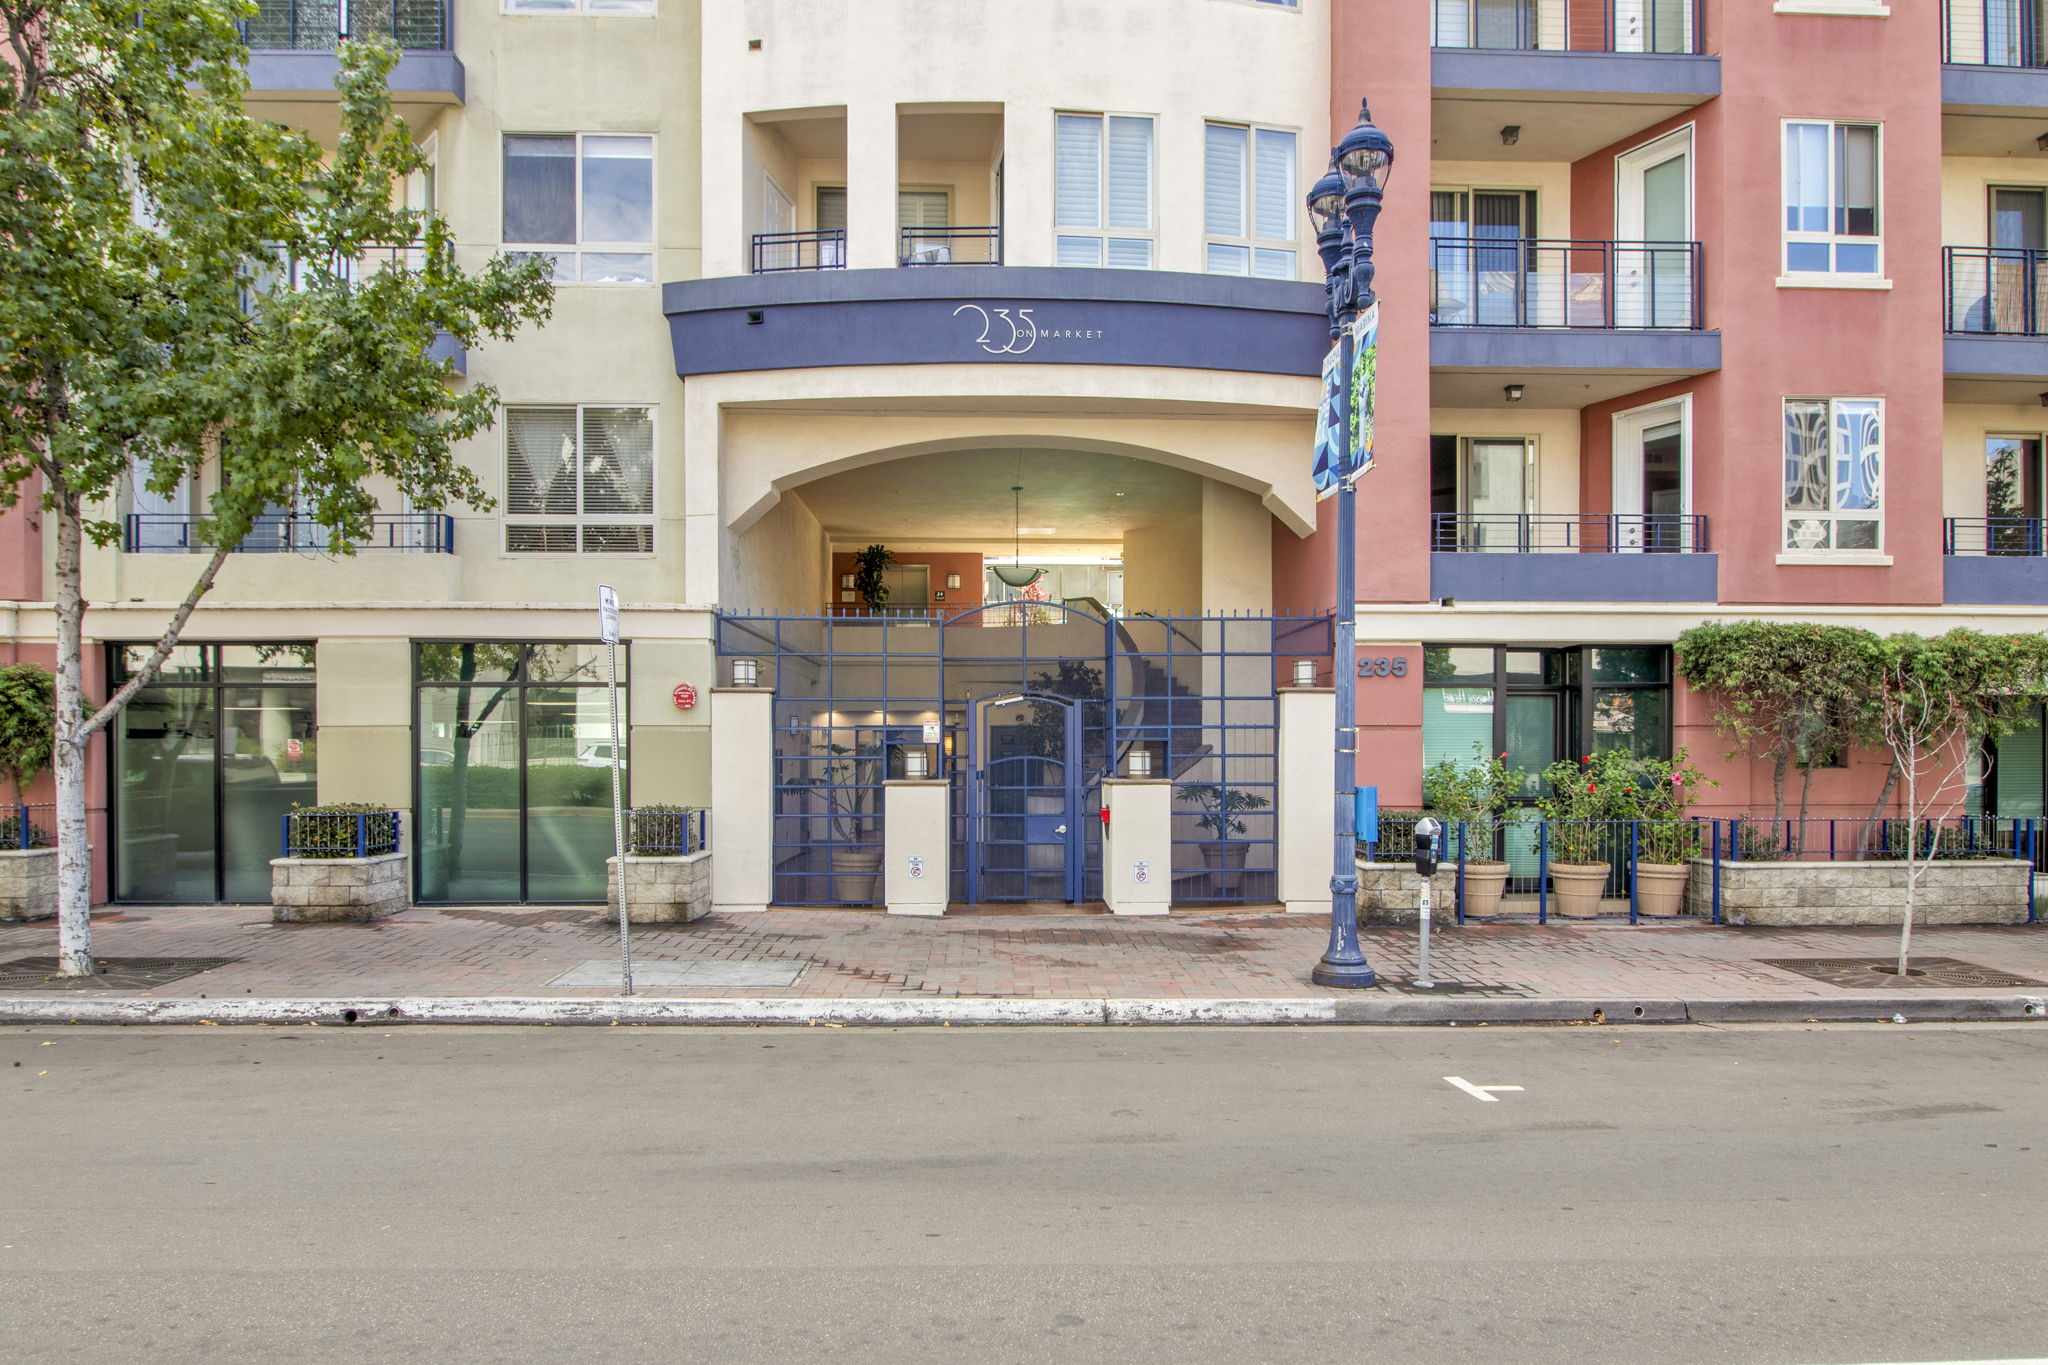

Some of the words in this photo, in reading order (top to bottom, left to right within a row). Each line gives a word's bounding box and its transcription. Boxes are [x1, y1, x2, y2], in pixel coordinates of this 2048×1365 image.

[953, 304, 1037, 354] 235
[1016, 329, 1033, 338] ON
[1040, 330, 1103, 339] MARKET
[1354, 310, 1376, 335] MARINA
[1357, 656, 1408, 677] 235
